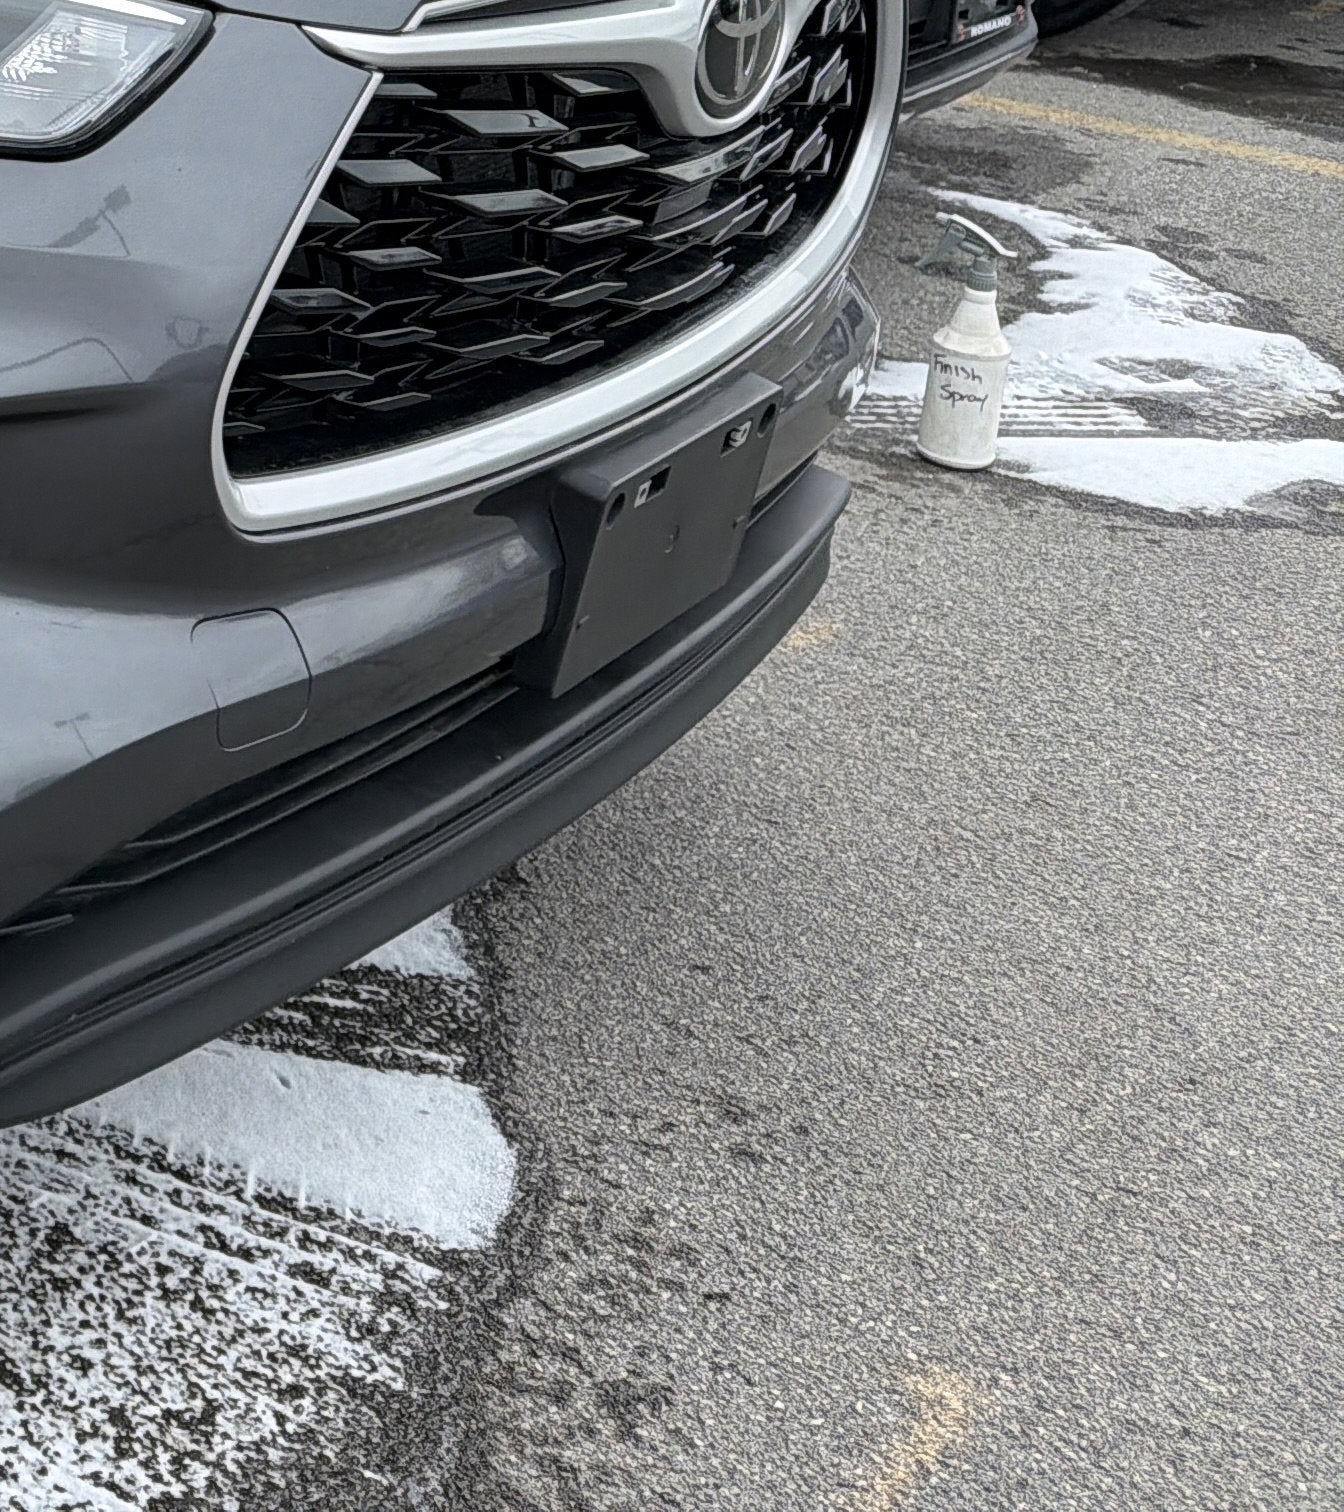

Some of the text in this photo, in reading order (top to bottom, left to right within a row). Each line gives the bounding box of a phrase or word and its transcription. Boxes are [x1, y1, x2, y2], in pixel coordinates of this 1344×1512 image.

[971, 15, 1011, 37] ROMANO
[933, 353, 983, 384] Finish
[940, 383, 989, 412] Spray
